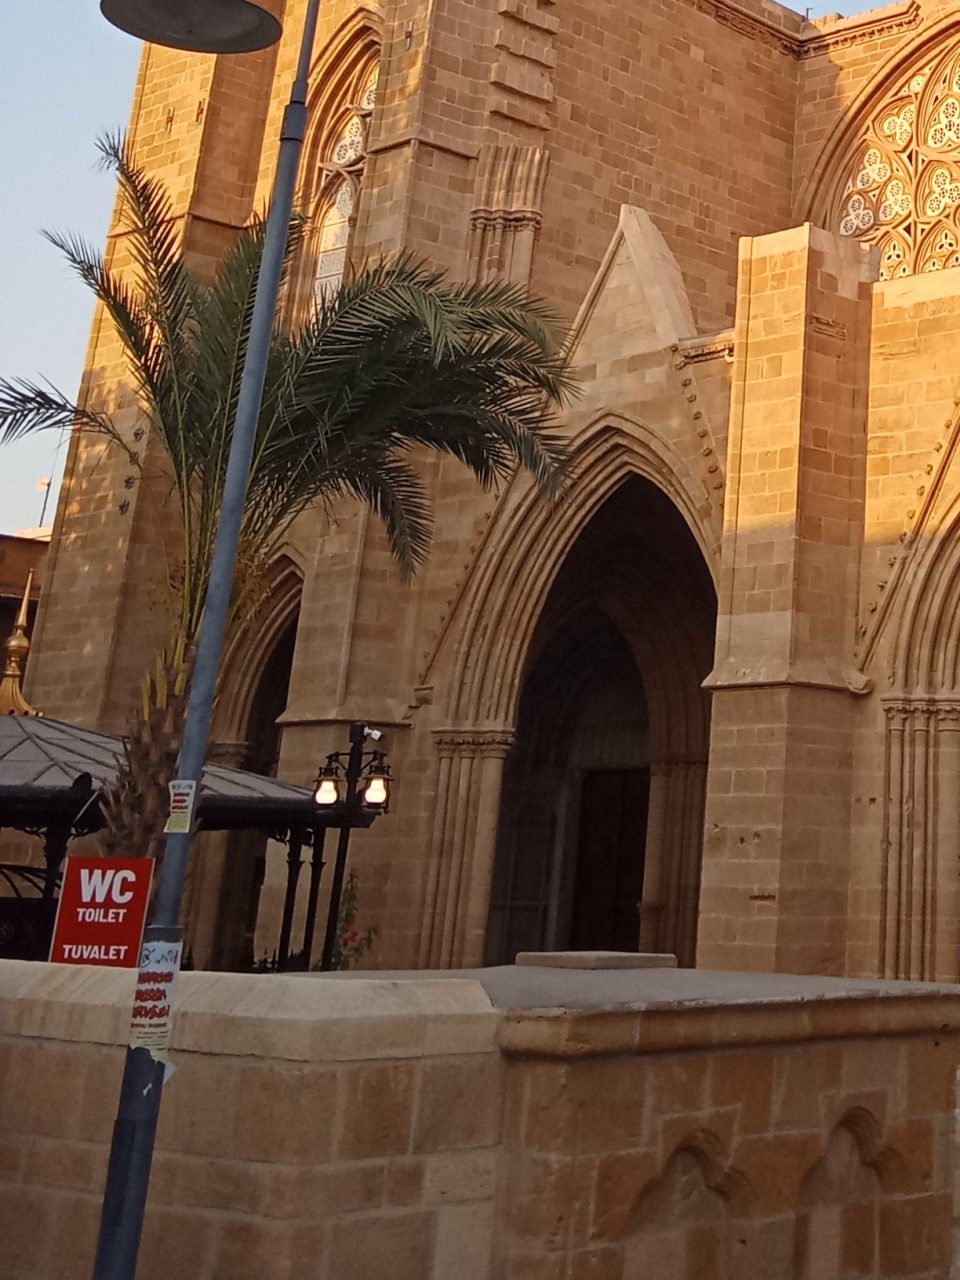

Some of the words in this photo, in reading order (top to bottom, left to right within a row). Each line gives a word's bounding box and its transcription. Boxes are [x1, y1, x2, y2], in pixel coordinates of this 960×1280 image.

[80, 869, 136, 904] WC
[77, 908, 127, 923] TOILET
[63, 944, 128, 960] TUVALET
